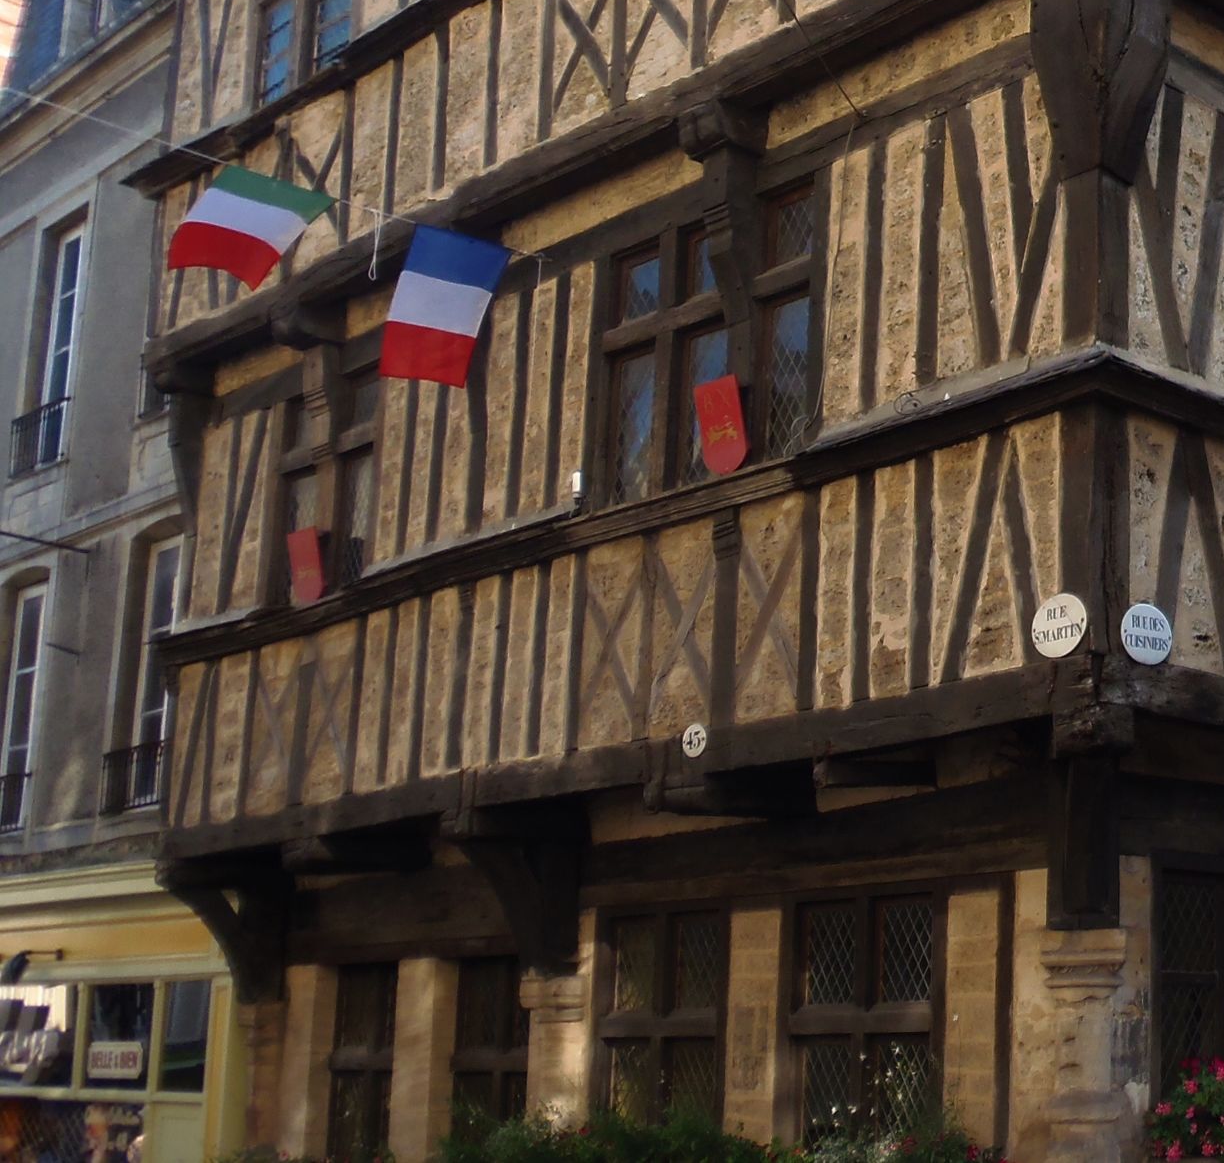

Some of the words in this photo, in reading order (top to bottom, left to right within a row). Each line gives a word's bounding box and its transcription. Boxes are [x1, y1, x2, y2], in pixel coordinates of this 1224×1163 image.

[1046, 605, 1067, 622] RUE
[1131, 614, 1149, 629] RUE
[1149, 616, 1165, 632] DES
[1124, 633, 1169, 652] CUISINIERS
[686, 730, 701, 750] 45
